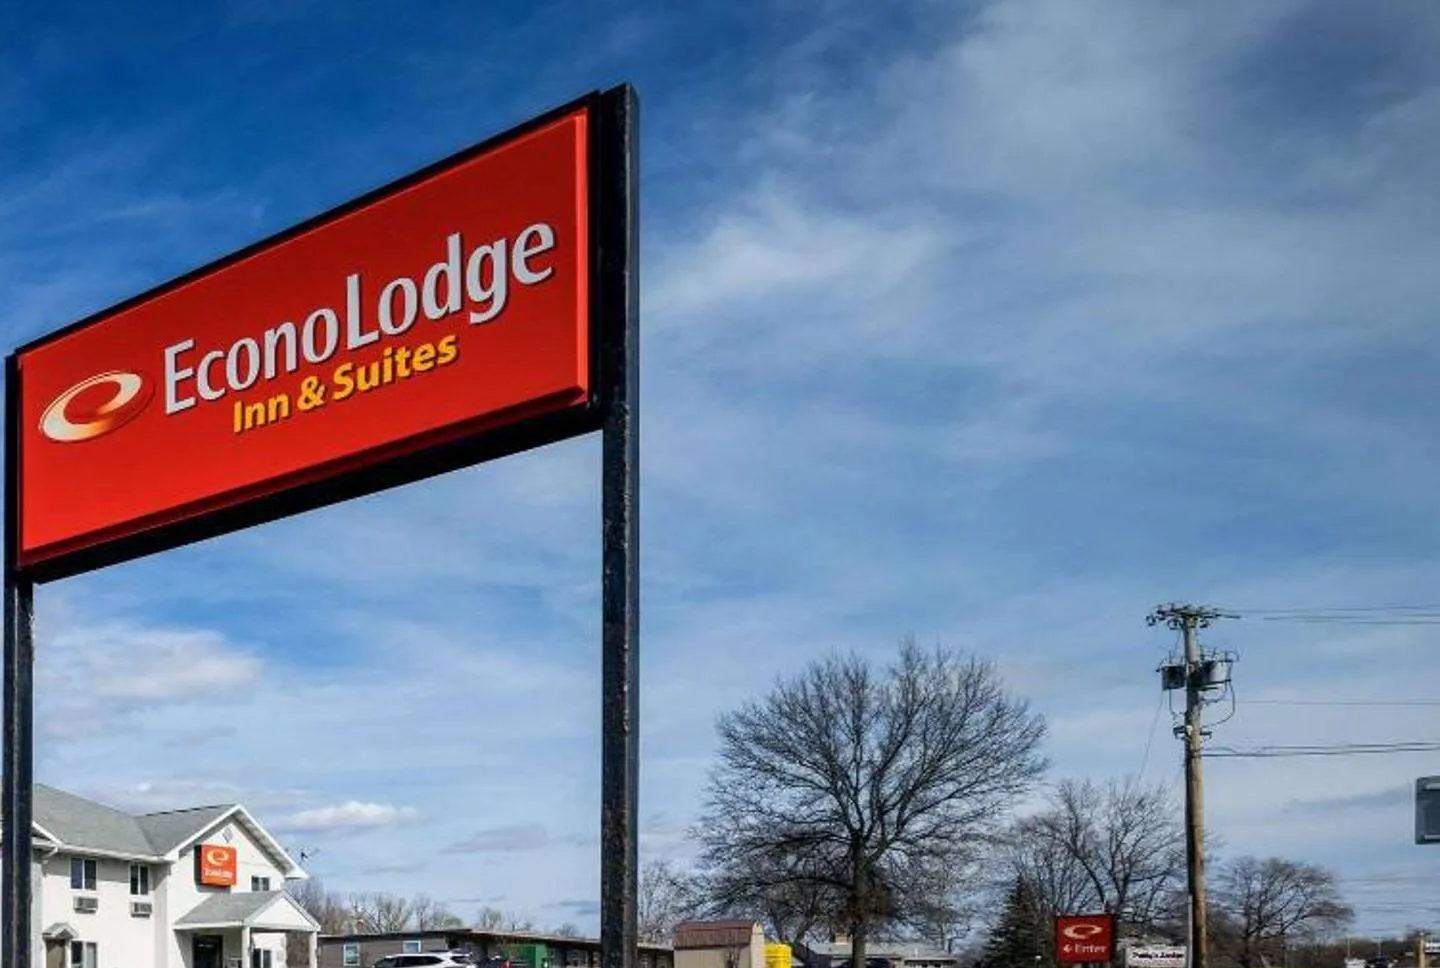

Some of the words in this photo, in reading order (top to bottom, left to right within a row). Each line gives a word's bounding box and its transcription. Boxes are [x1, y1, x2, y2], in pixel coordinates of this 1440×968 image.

[232, 397, 289, 434] Inn
[296, 380, 326, 413] &
[332, 334, 458, 401] Suites
[1074, 943, 1107, 953] Enter
